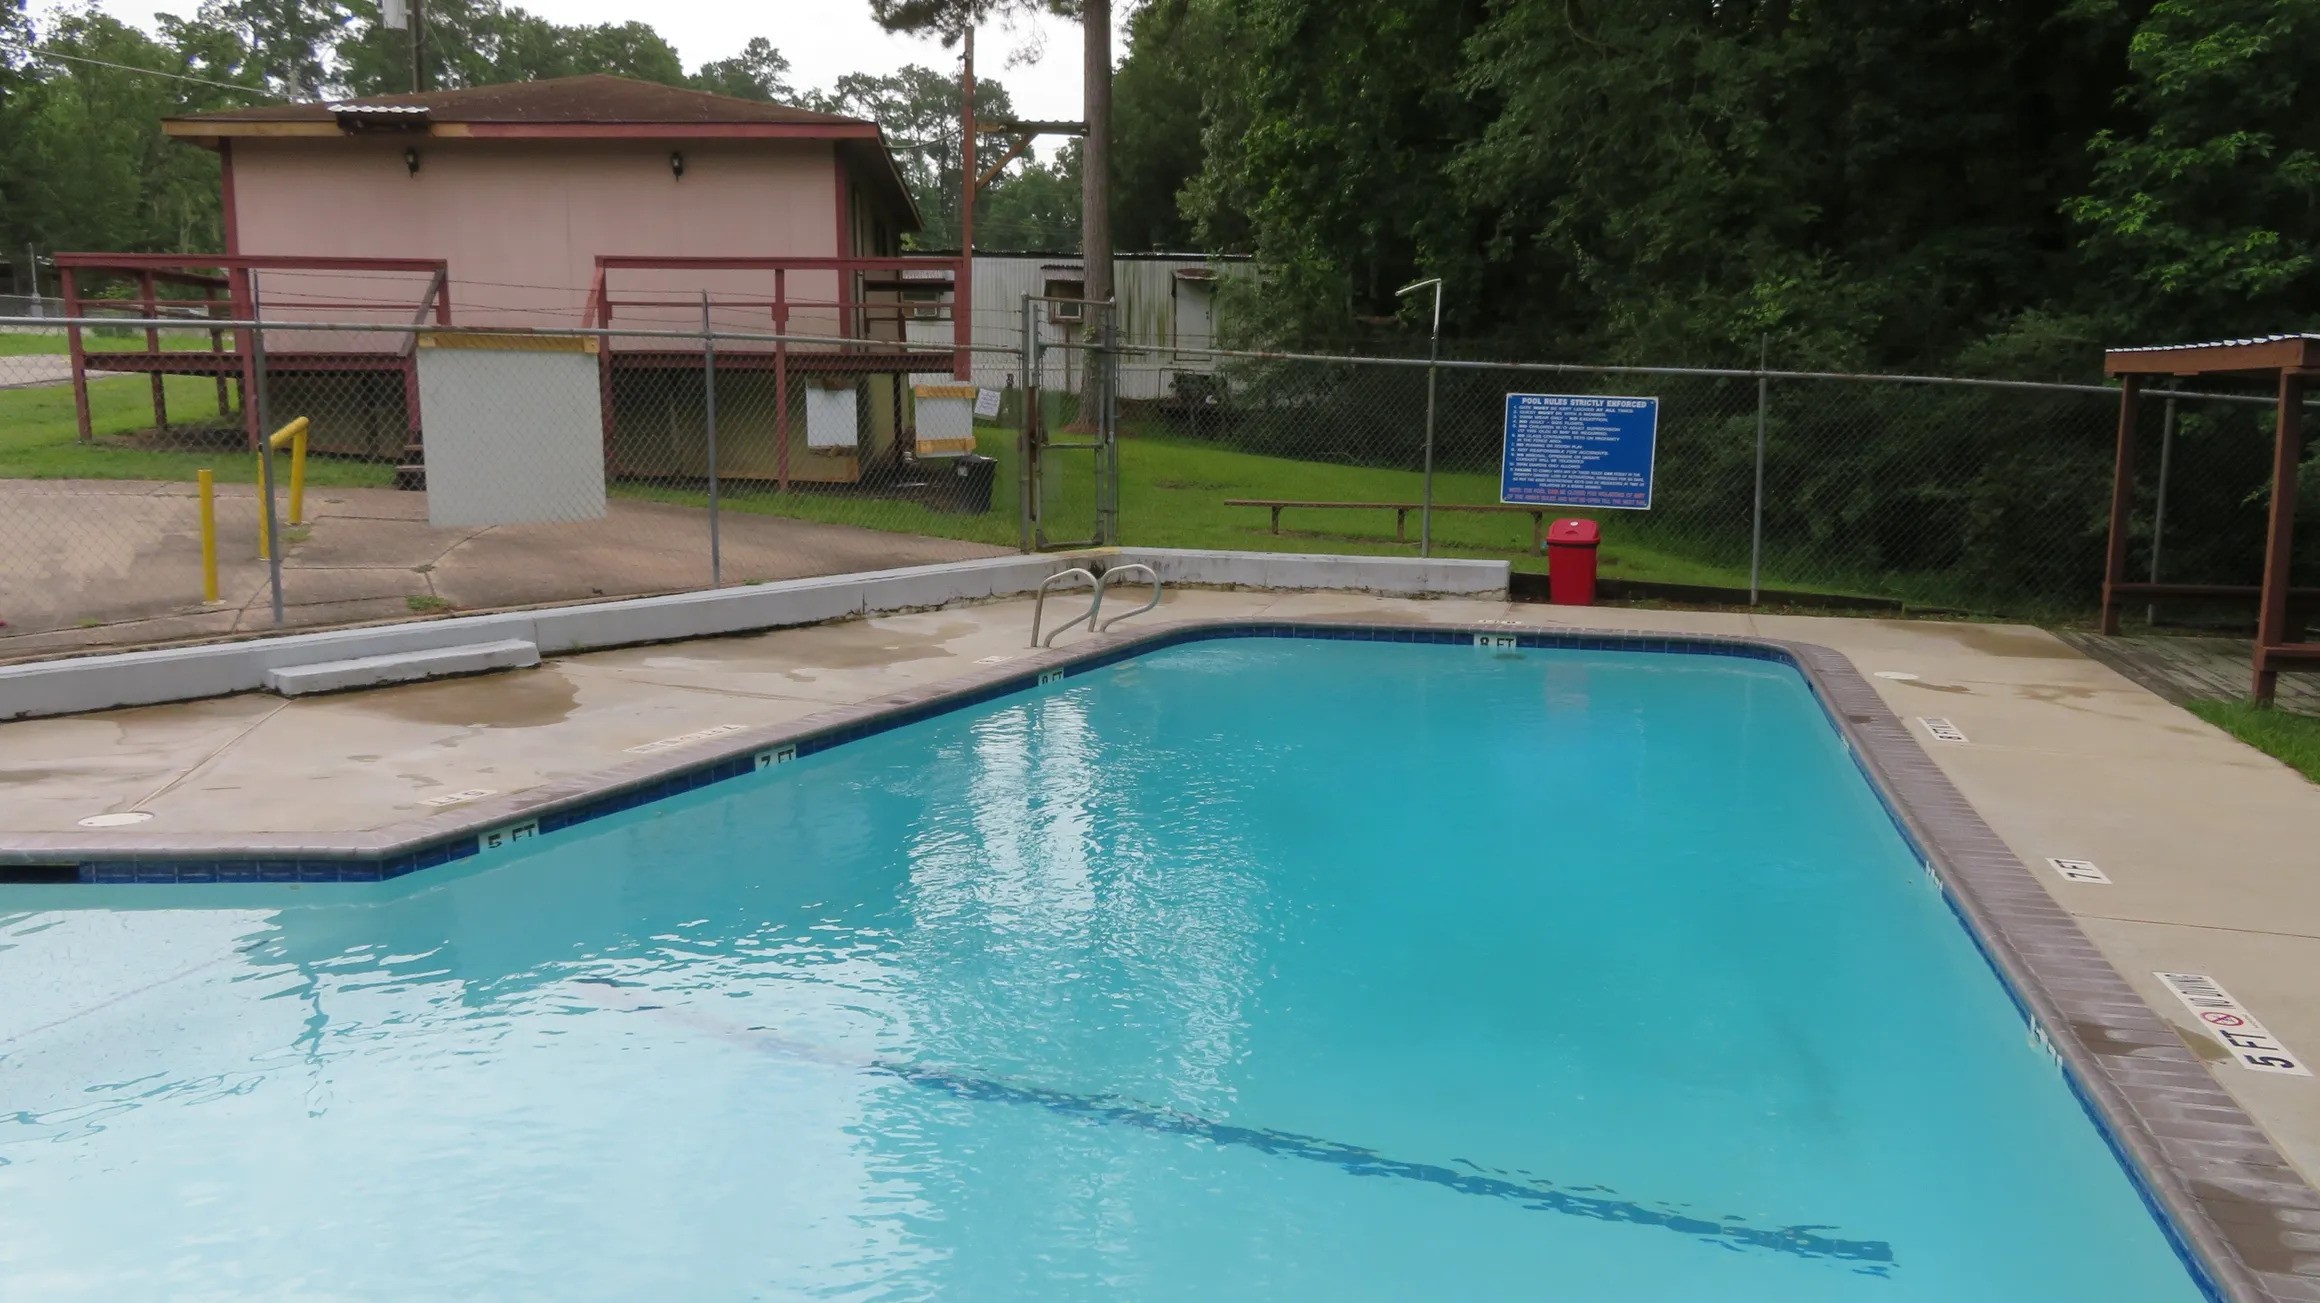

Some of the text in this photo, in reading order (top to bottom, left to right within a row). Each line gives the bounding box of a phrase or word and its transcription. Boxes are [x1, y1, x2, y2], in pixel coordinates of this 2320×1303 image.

[1569, 398, 1604, 406] STRICTLY
[1606, 399, 1647, 407] ENFORCED
[487, 833, 502, 849] 5
[2219, 1029, 2280, 1051] FT
[2243, 1054, 2296, 1069] 5
